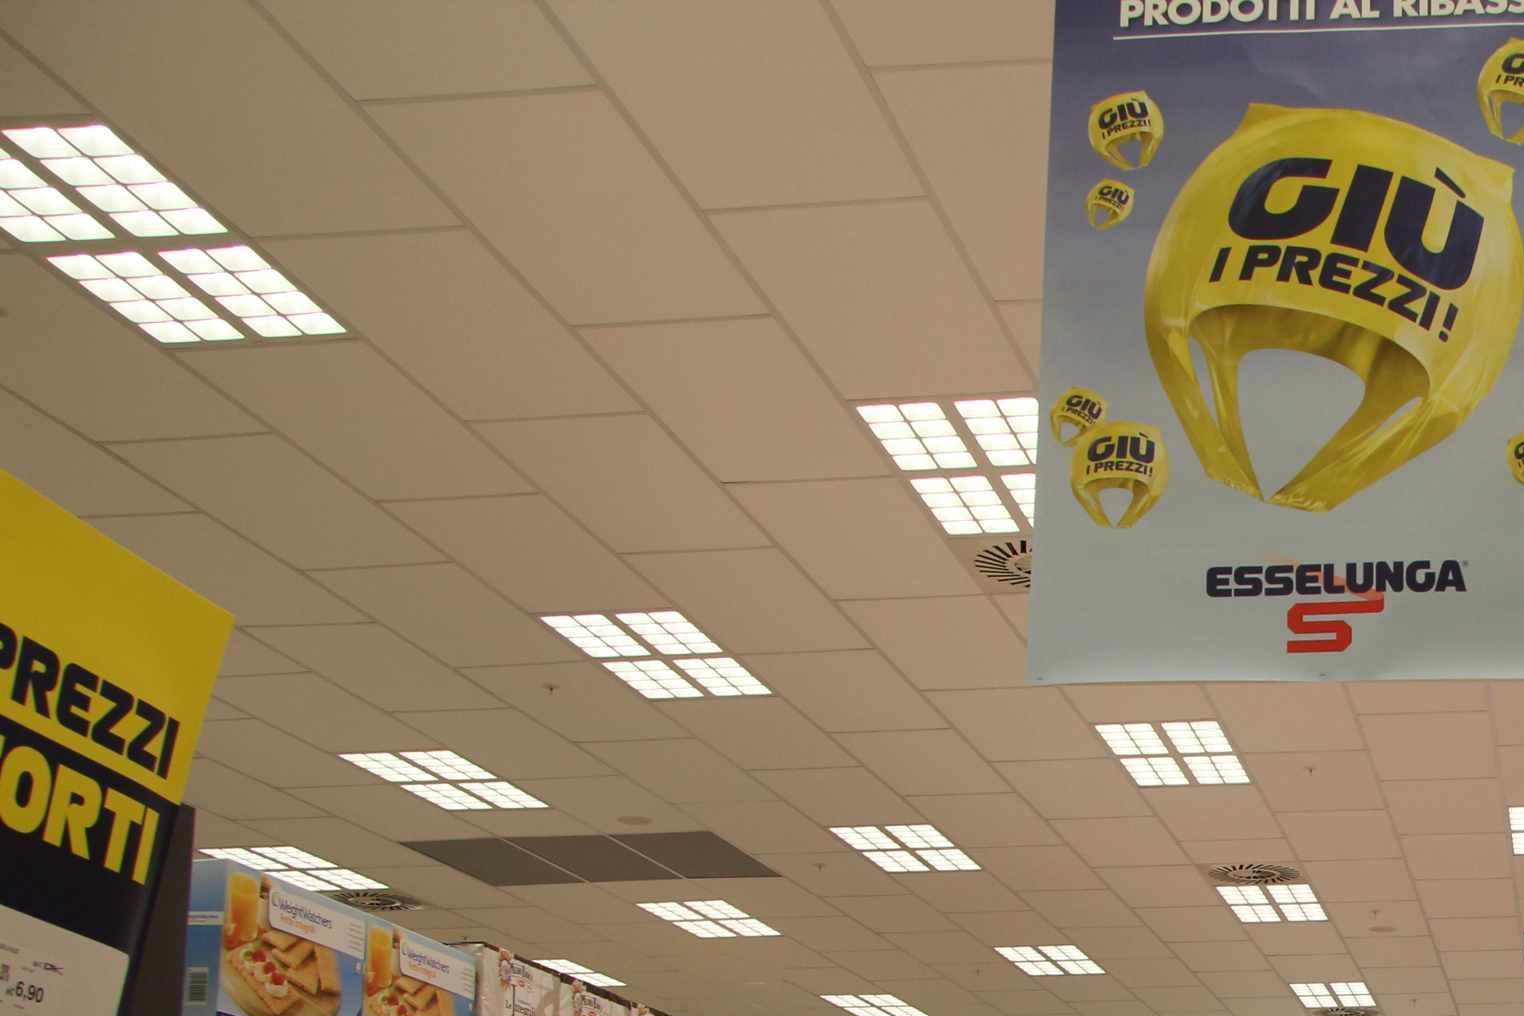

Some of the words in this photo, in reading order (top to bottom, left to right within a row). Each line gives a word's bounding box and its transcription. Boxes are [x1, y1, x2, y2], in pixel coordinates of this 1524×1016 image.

[1098, 98, 1149, 129] GIÙ
[1228, 157, 1484, 290] GIÙ
[1209, 247, 1232, 283] I
[1240, 245, 1459, 343] PREZZI!
[1066, 395, 1102, 420] GIÙ
[1087, 432, 1155, 464] GIÙ
[1206, 559, 1467, 598] ESSELUNGA
[0, 733, 160, 885] ORTI
